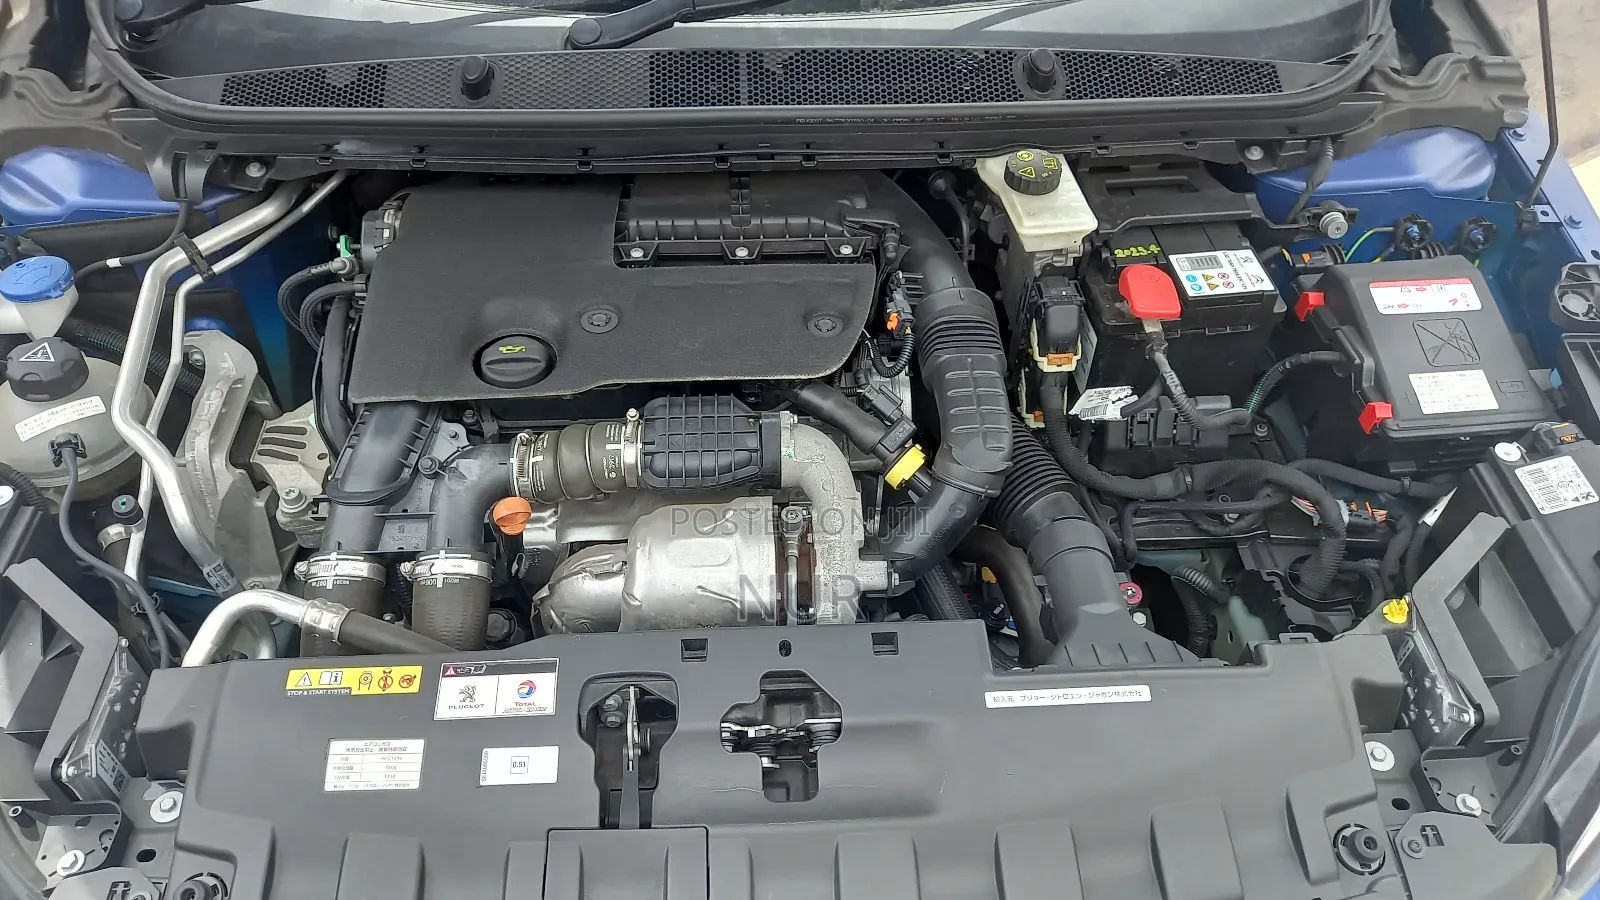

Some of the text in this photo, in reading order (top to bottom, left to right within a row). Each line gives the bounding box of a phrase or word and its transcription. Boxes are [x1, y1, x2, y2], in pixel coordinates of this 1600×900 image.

[286, 689, 302, 697] STOP
[993, 694, 1015, 703] 輸入元
